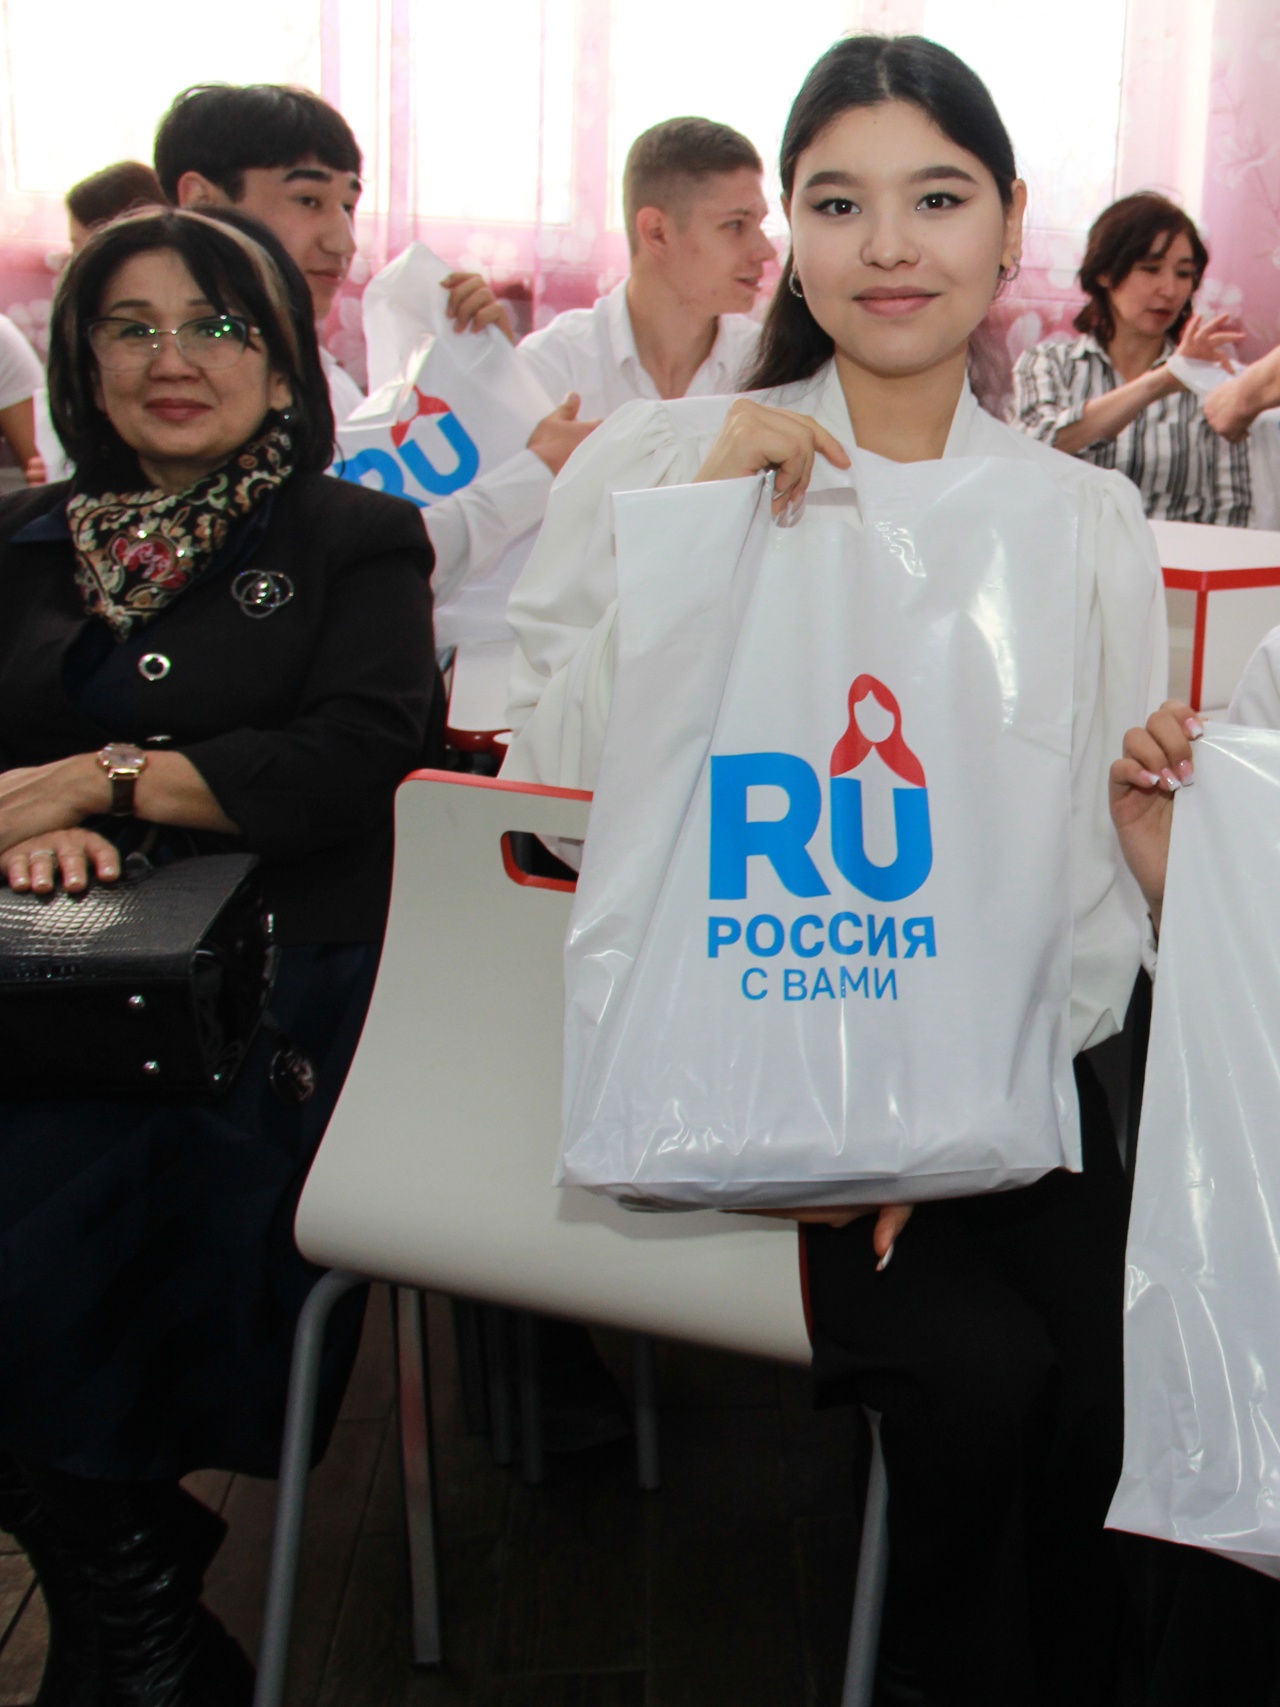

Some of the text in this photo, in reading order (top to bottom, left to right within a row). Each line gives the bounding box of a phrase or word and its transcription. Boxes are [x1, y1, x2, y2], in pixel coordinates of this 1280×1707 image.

[708, 751, 934, 903] RU
[707, 910, 937, 960] РОССИЯ
[740, 965, 898, 1002] С ВАМИ
